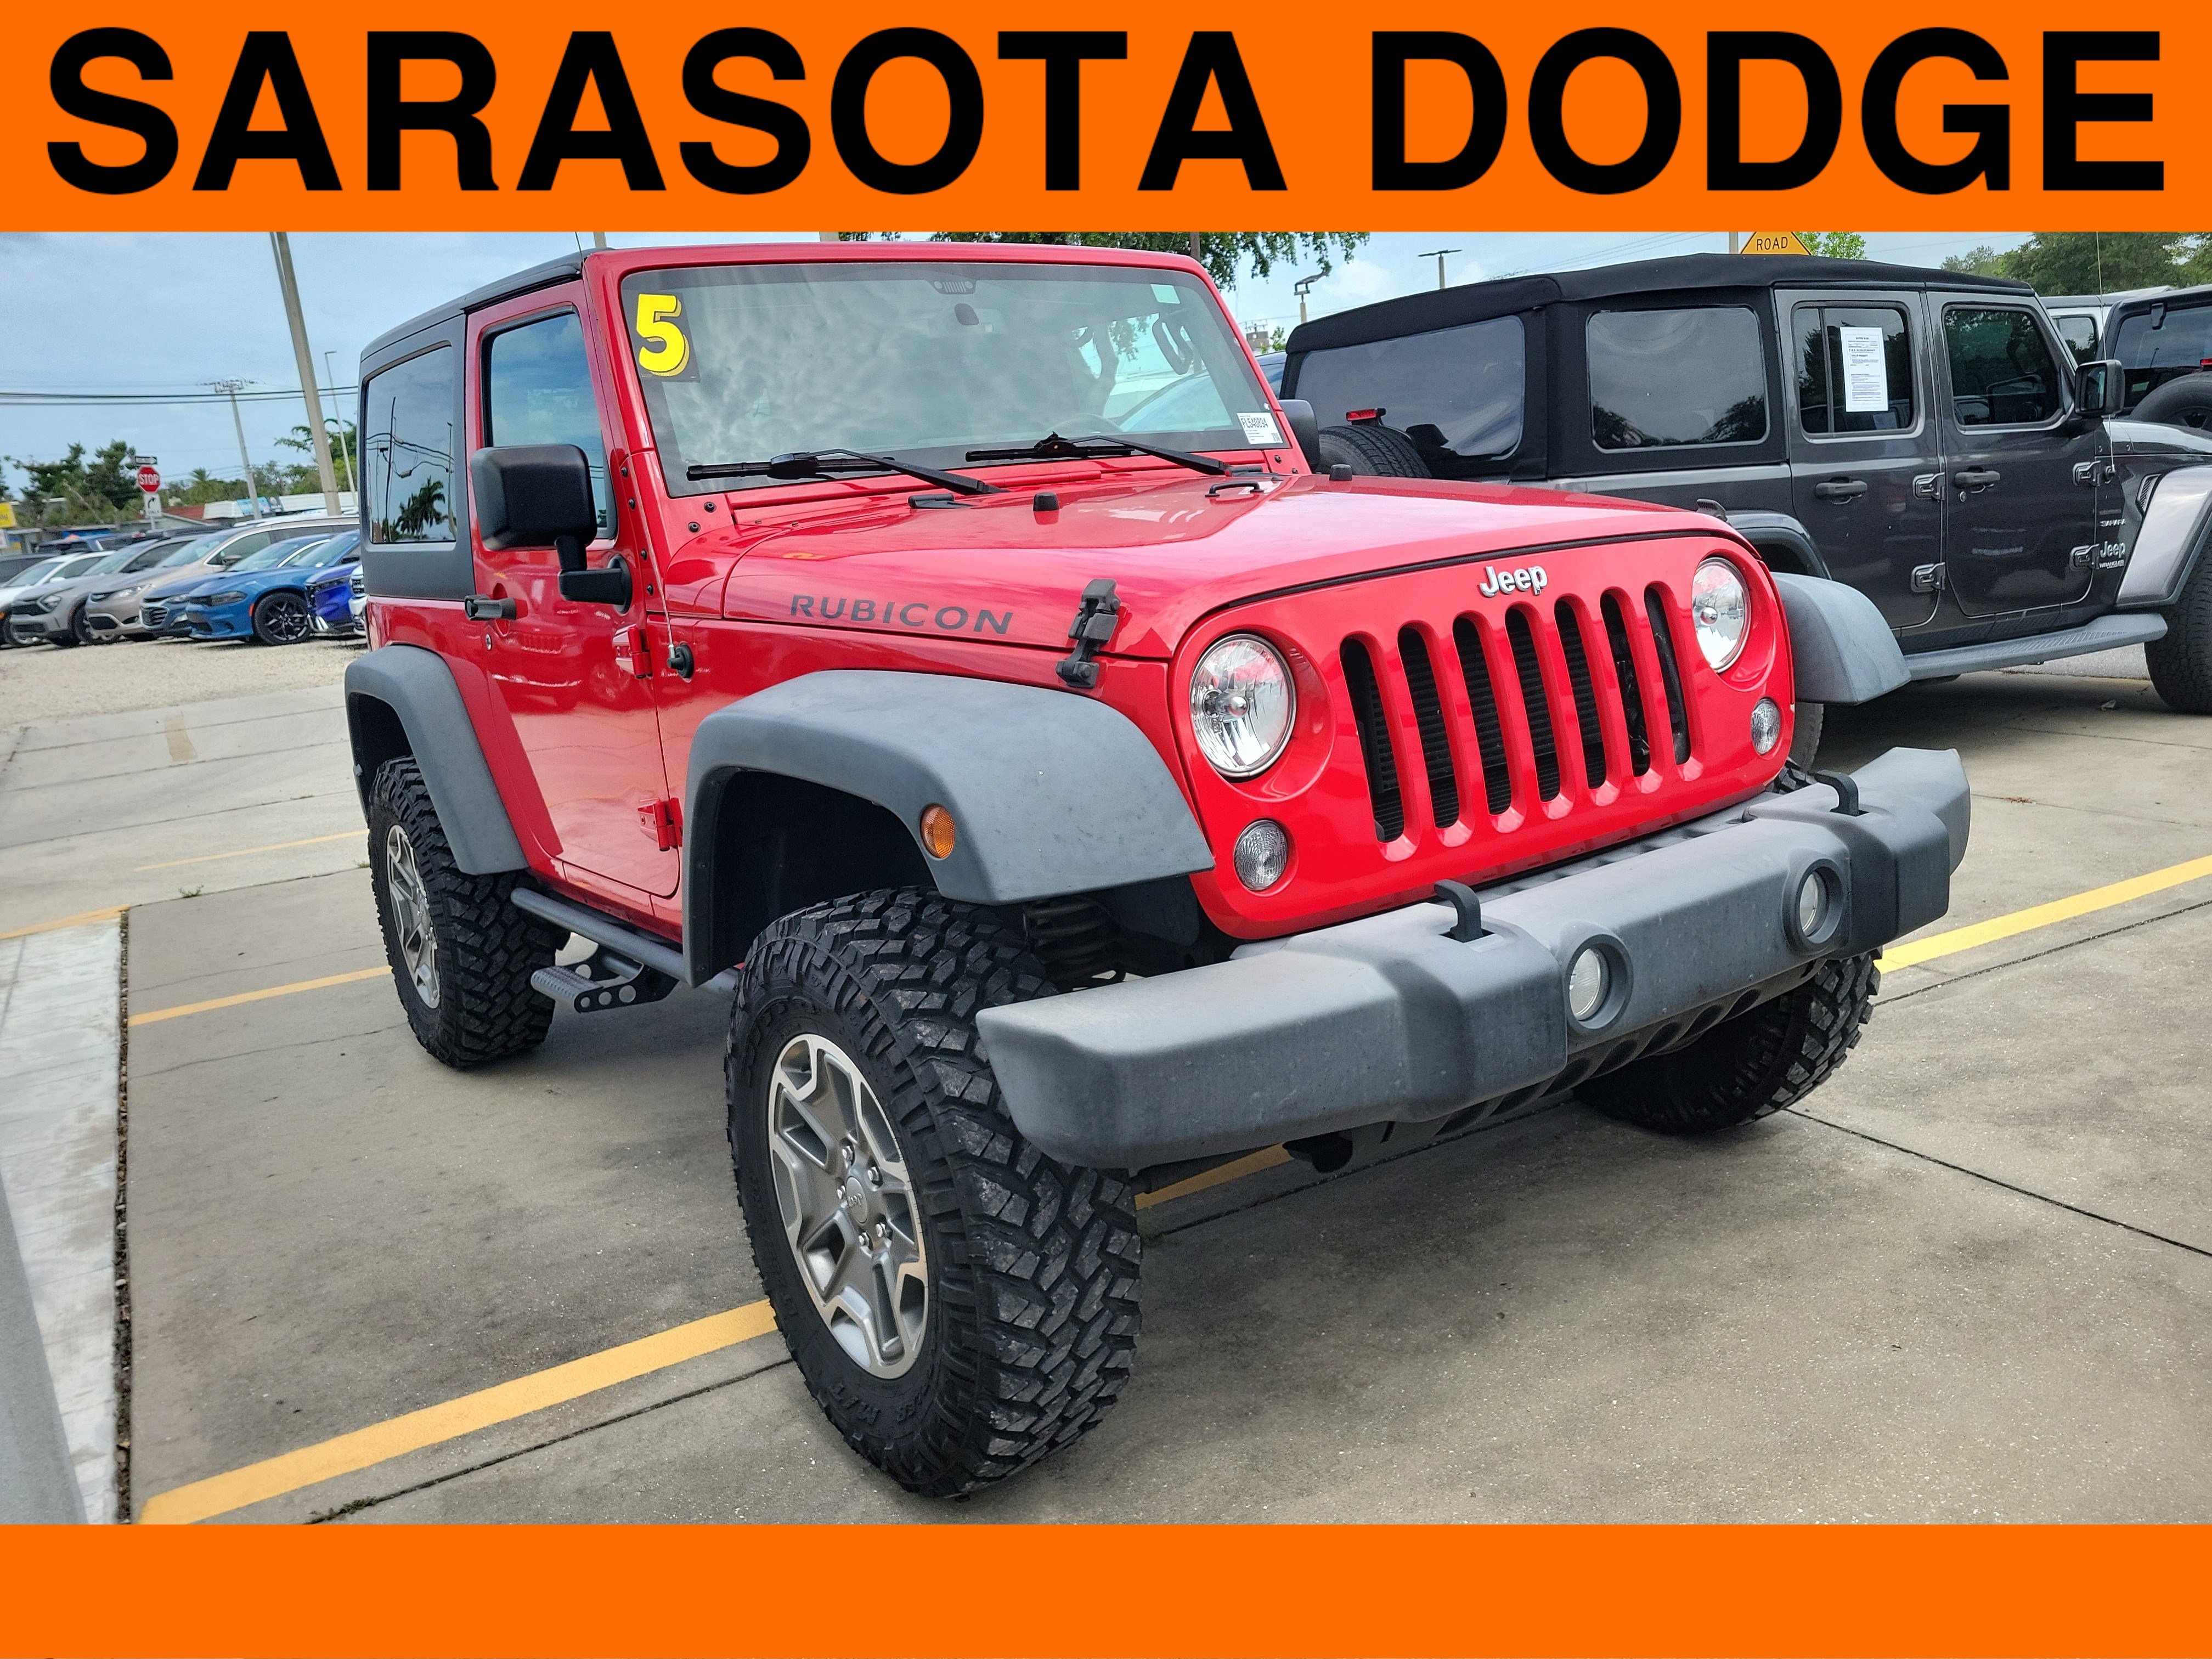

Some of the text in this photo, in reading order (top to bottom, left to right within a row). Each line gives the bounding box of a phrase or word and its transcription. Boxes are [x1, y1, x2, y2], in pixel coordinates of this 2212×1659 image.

[1757, 236, 1788, 251] ROAD
[636, 293, 690, 377] 5
[1240, 417, 1268, 428] FL540894
[139, 473, 159, 485] STOP
[2100, 540, 2126, 558] Jeep
[1480, 566, 1548, 597] Jeep
[790, 594, 1013, 635] RUBICON
